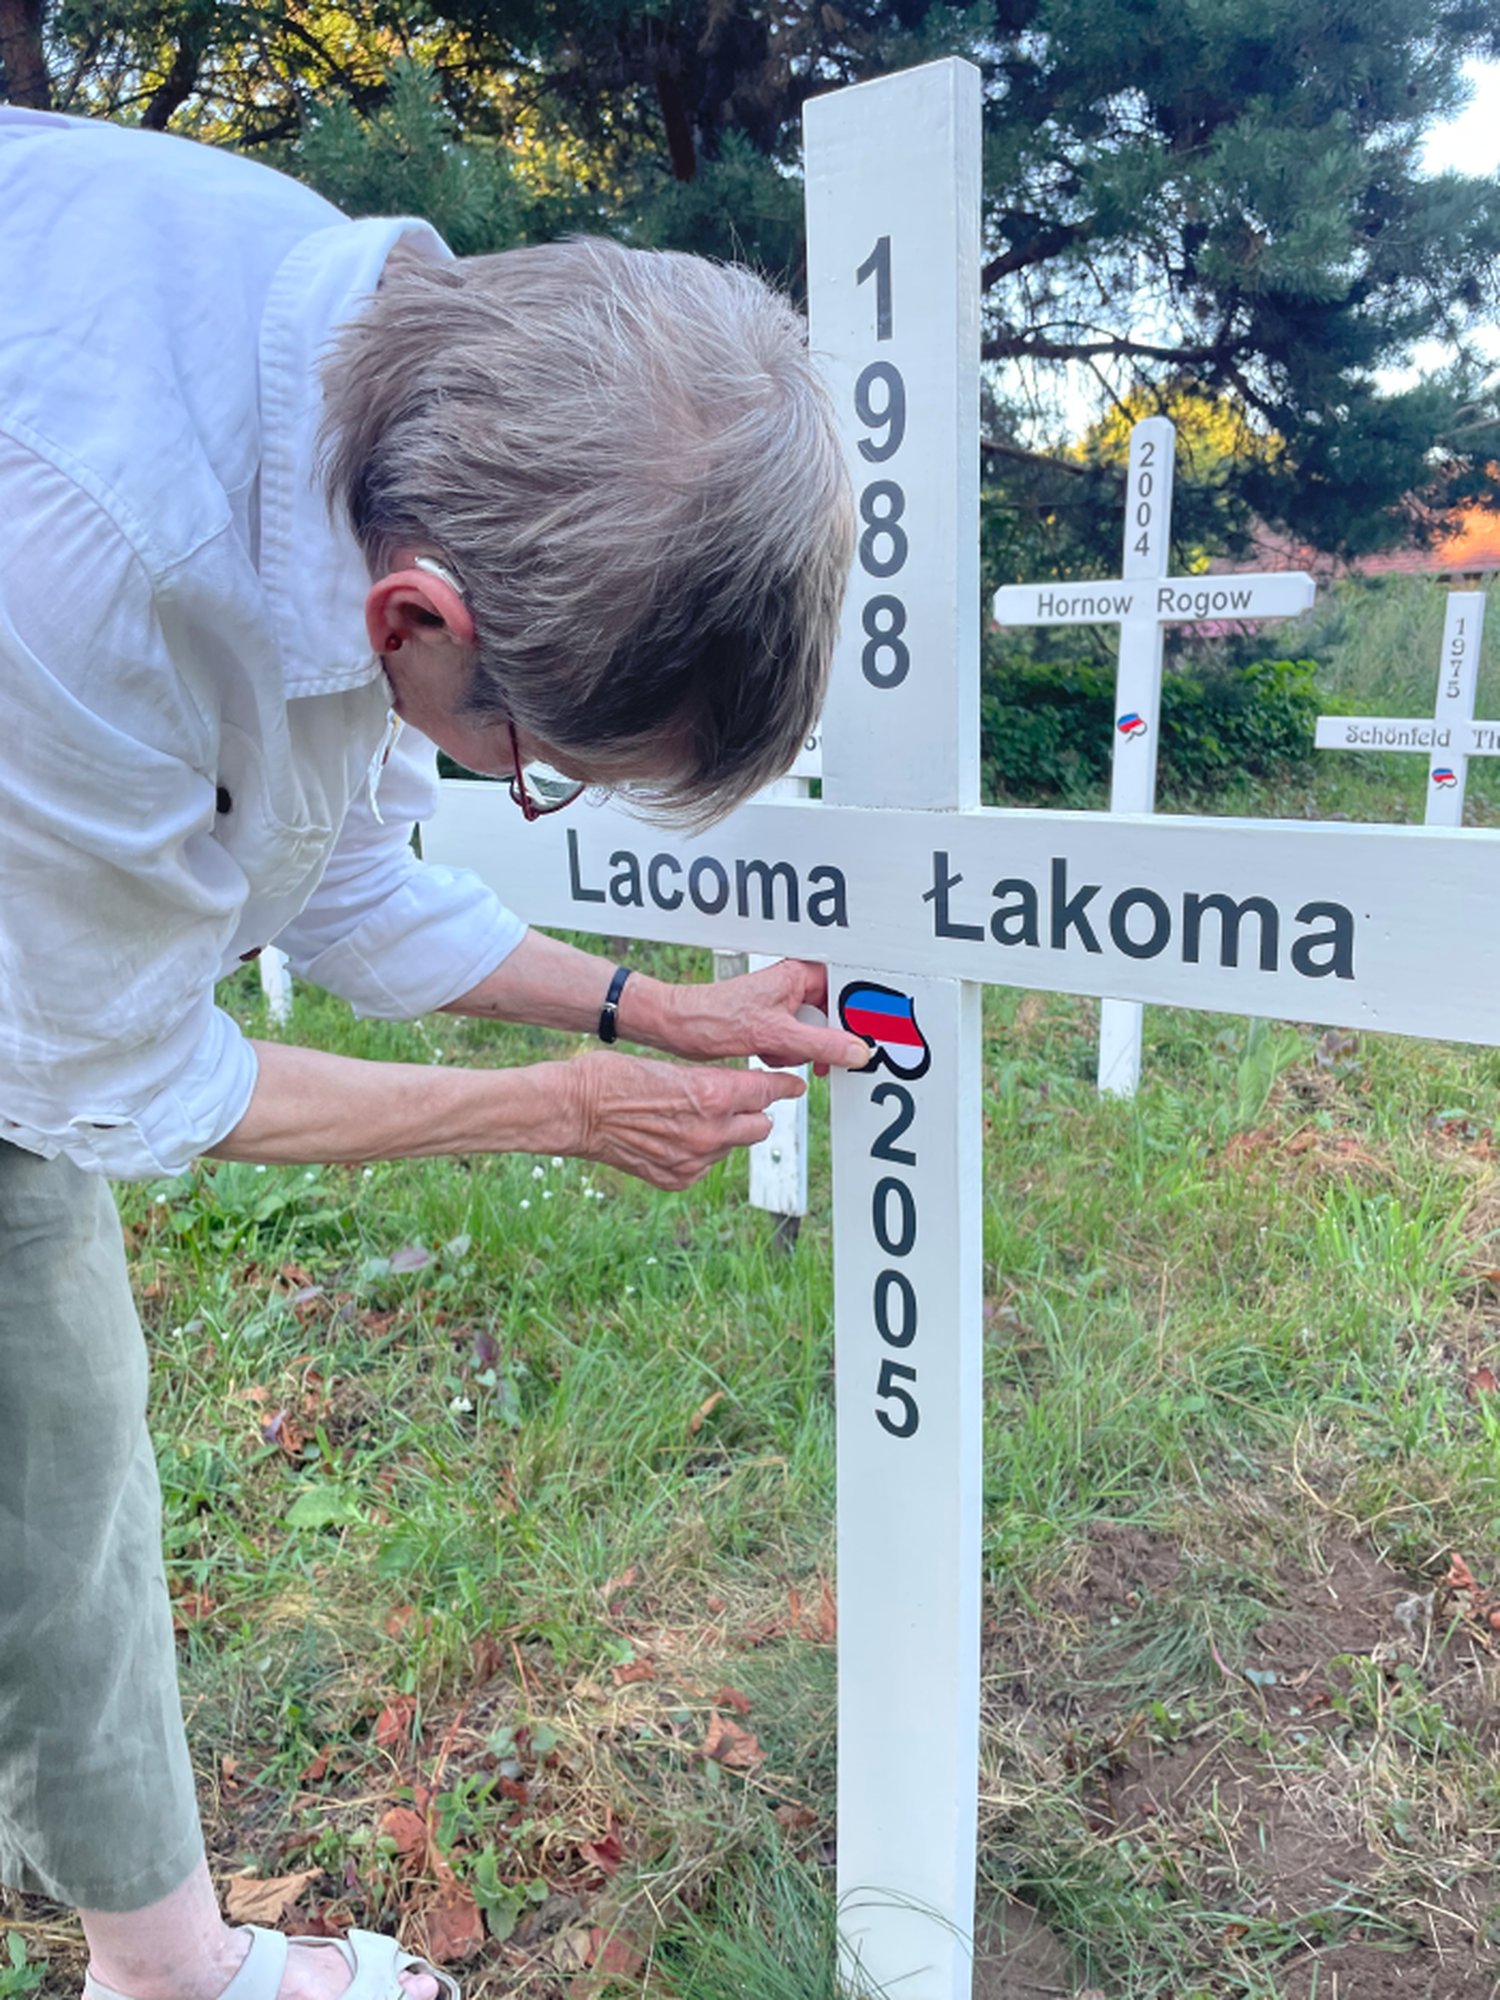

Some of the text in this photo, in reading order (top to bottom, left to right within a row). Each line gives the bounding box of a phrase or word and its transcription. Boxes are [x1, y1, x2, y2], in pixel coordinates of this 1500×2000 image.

[854, 234, 911, 690] 1988
[1134, 441, 1155, 557] 2004
[1037, 587, 1253, 618] Hornow Rogow
[1446, 617, 1466, 699] 1975
[1345, 724, 1452, 748] Schönfeld
[566, 828, 1356, 981] Lacoma Łakoma
[870, 1081, 921, 1439] 2005
